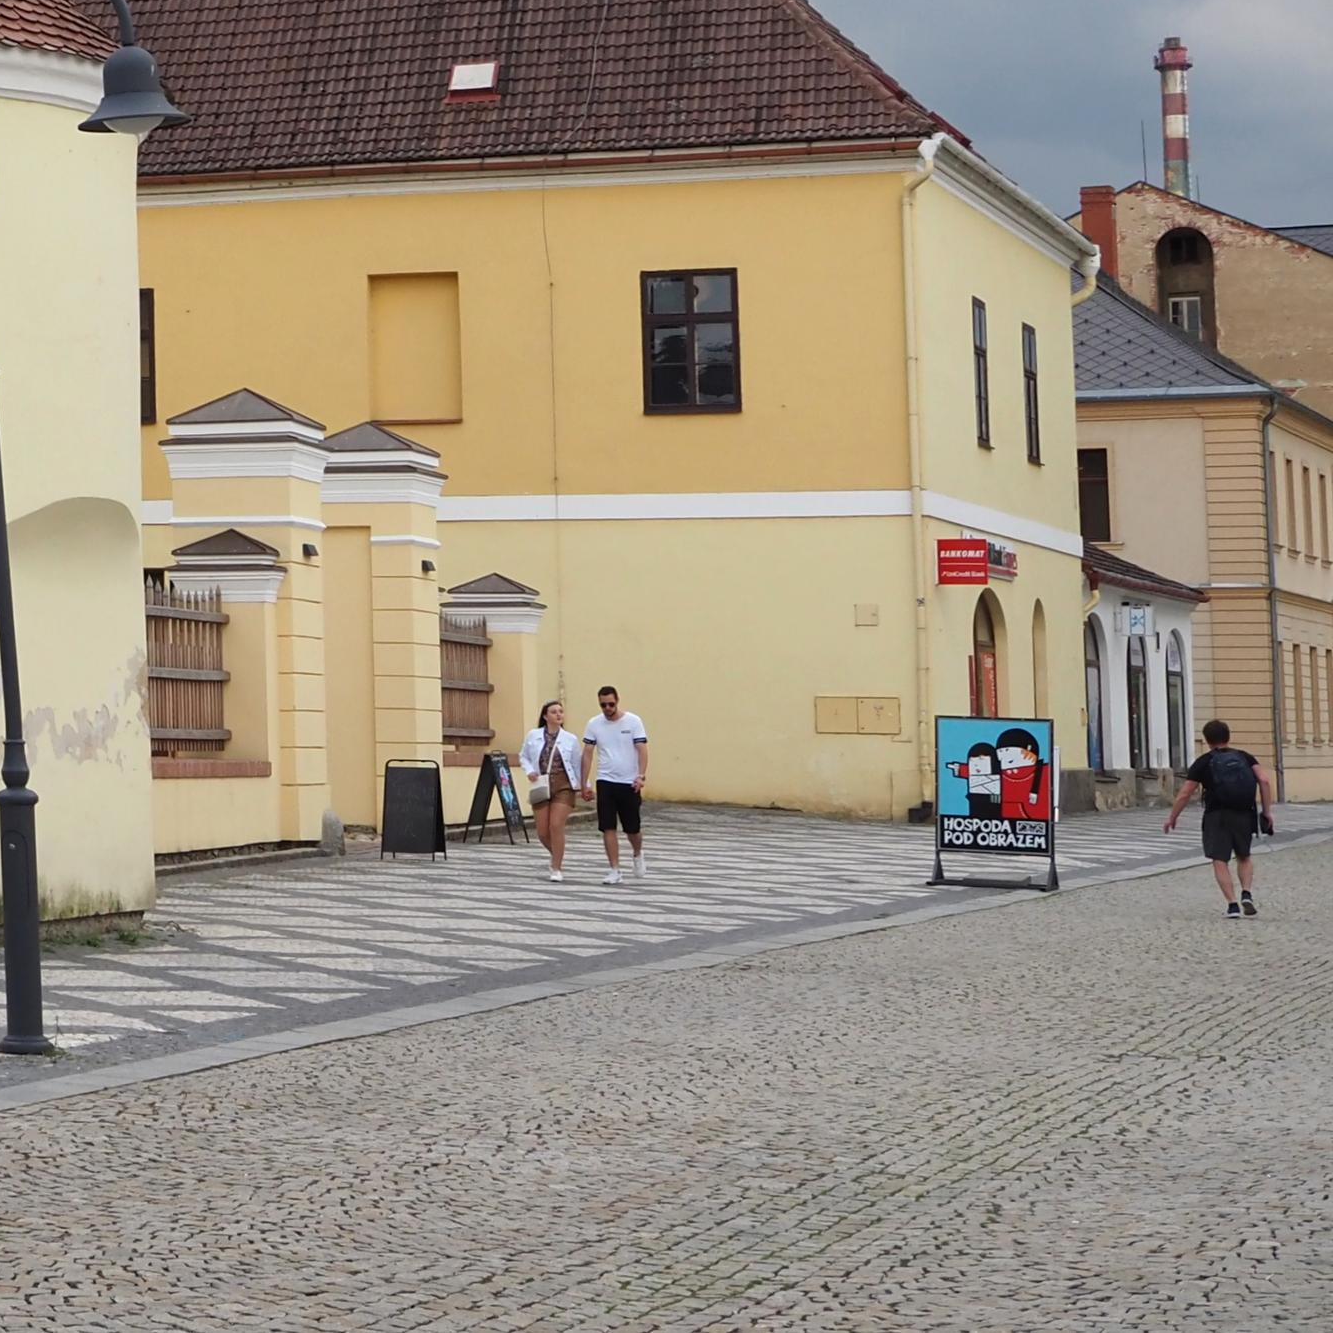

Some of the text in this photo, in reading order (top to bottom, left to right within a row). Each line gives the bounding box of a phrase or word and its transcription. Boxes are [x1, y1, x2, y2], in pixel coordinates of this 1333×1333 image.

[940, 550, 985, 558] BANKOMAT
[943, 817, 1012, 834] HOSPODA
[944, 830, 1046, 849] POD OBRAZEM
